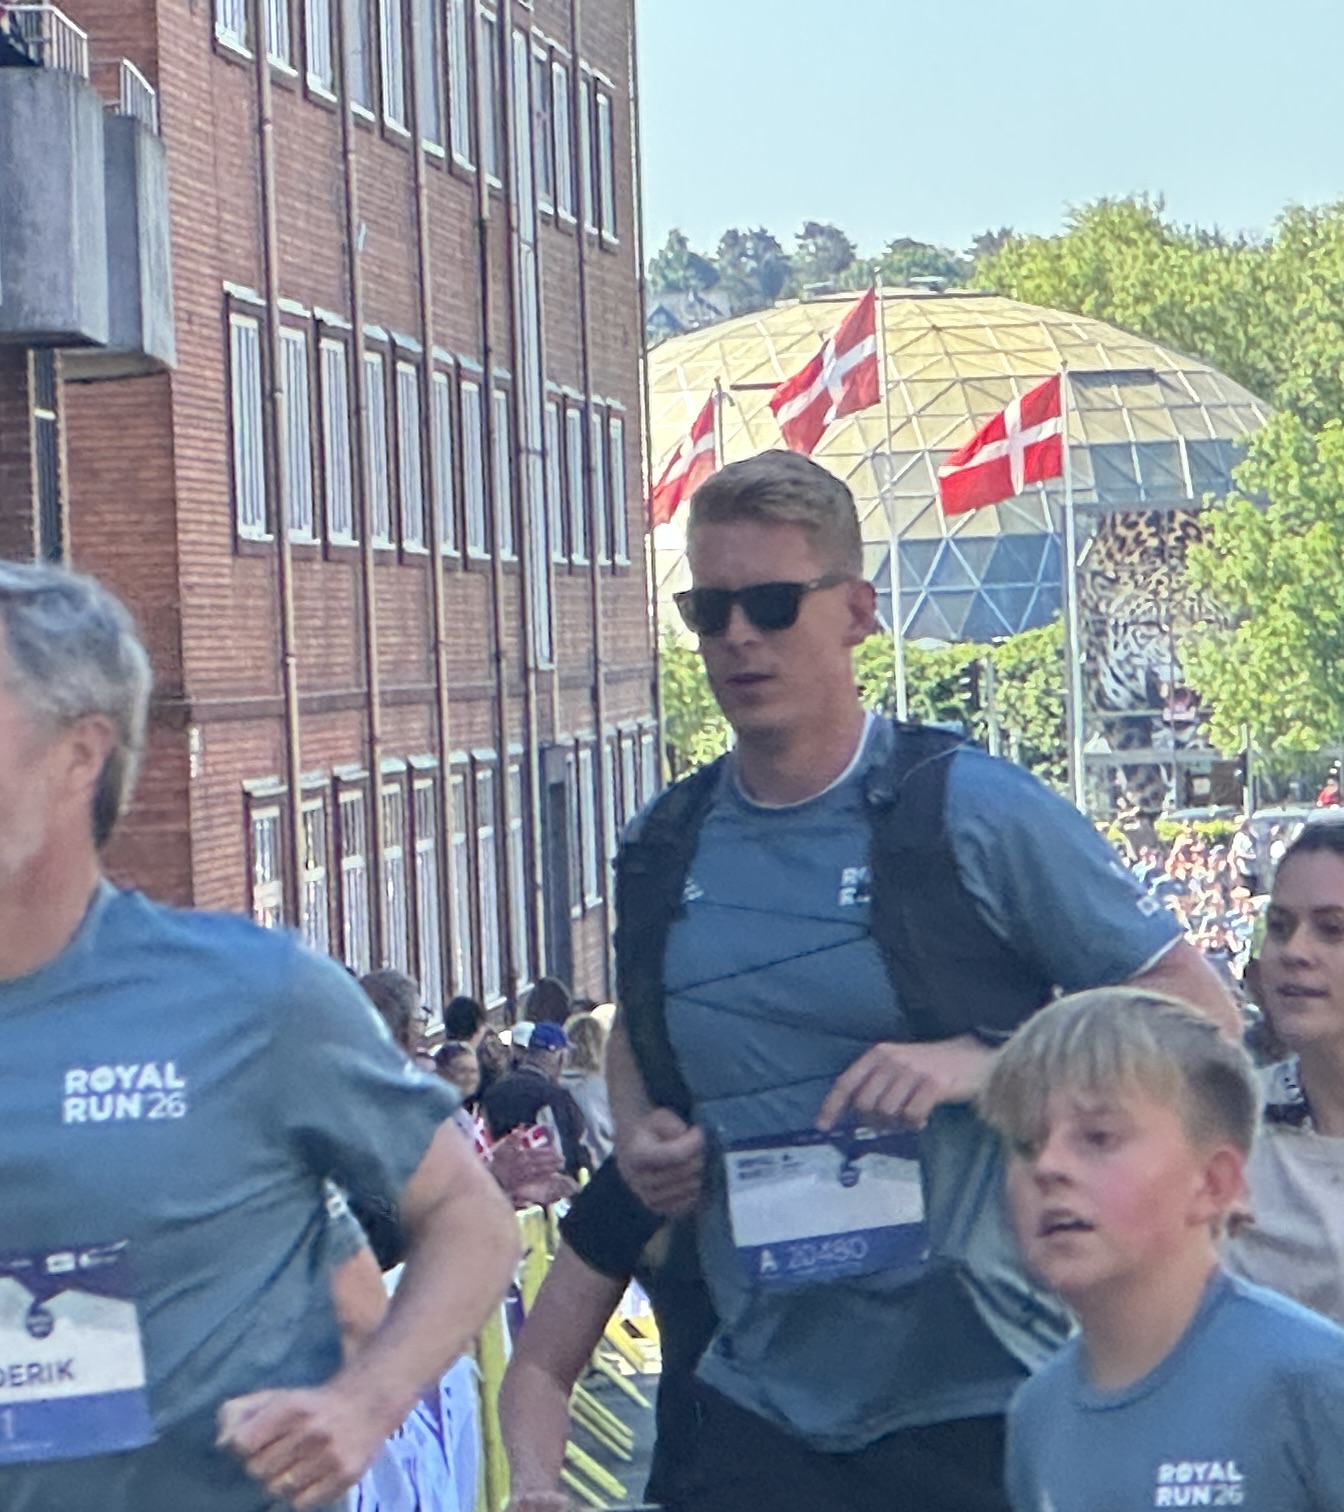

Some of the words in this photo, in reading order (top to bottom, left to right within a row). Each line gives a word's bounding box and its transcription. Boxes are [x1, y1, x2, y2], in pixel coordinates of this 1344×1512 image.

[65, 1062, 186, 1095] ROYAL
[761, 1250, 778, 1273] A
[3, 1408, 15, 1439] 1
[1158, 1460, 1244, 1484] ROYAL
